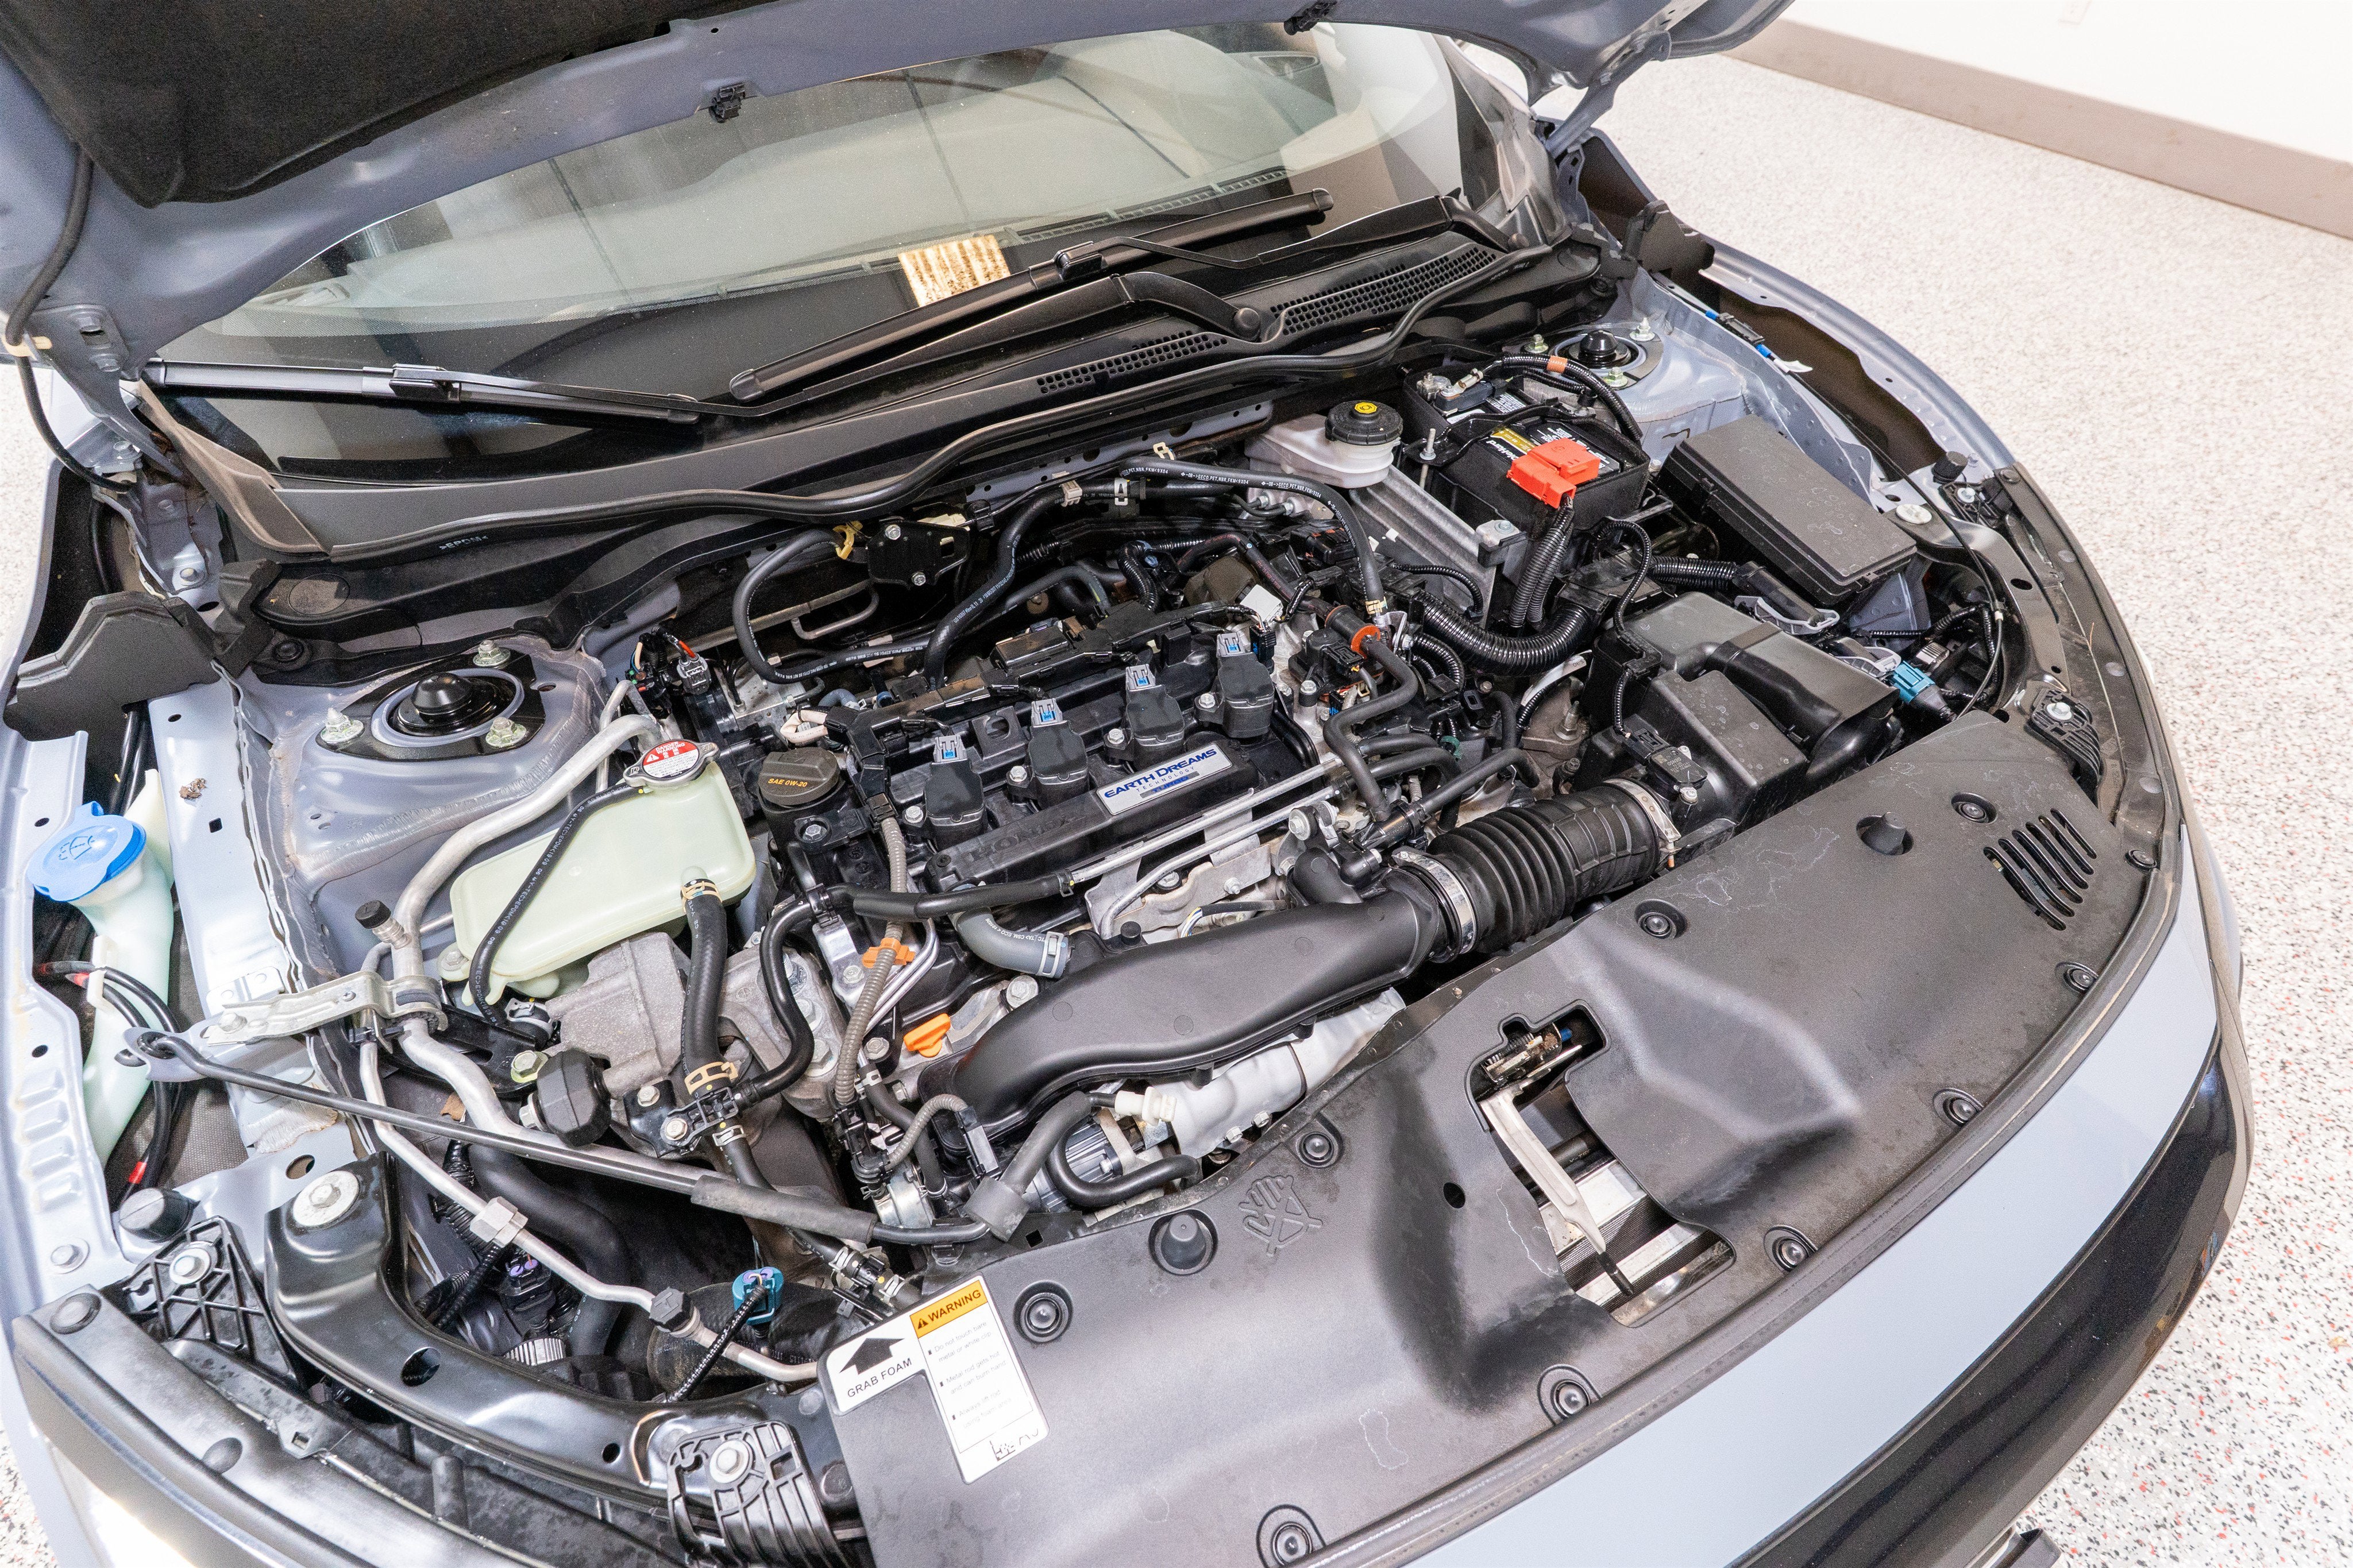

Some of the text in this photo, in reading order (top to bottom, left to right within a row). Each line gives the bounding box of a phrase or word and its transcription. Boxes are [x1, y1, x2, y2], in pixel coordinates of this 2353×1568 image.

[1486, 440, 1518, 461] DieHard
[655, 741, 679, 751] DANGER
[657, 743, 685, 754] WARNUNG
[785, 779, 808, 787] 0W-20
[1104, 748, 1217, 798] EARTH DREAMS
[1136, 766, 1195, 793] TECHNOLOGY
[1151, 775, 1189, 793] TURBO
[928, 1289, 982, 1323] WARNING
[934, 1320, 987, 1352] Do not touch bare
[938, 1350, 956, 1362] metal
[963, 1337, 980, 1349] white
[980, 1330, 993, 1341] clip
[847, 1357, 913, 1399] GRAB FOAM
[946, 1351, 1000, 1383] Metal rod gets hot
[949, 1360, 1006, 1395] and can burn hand
